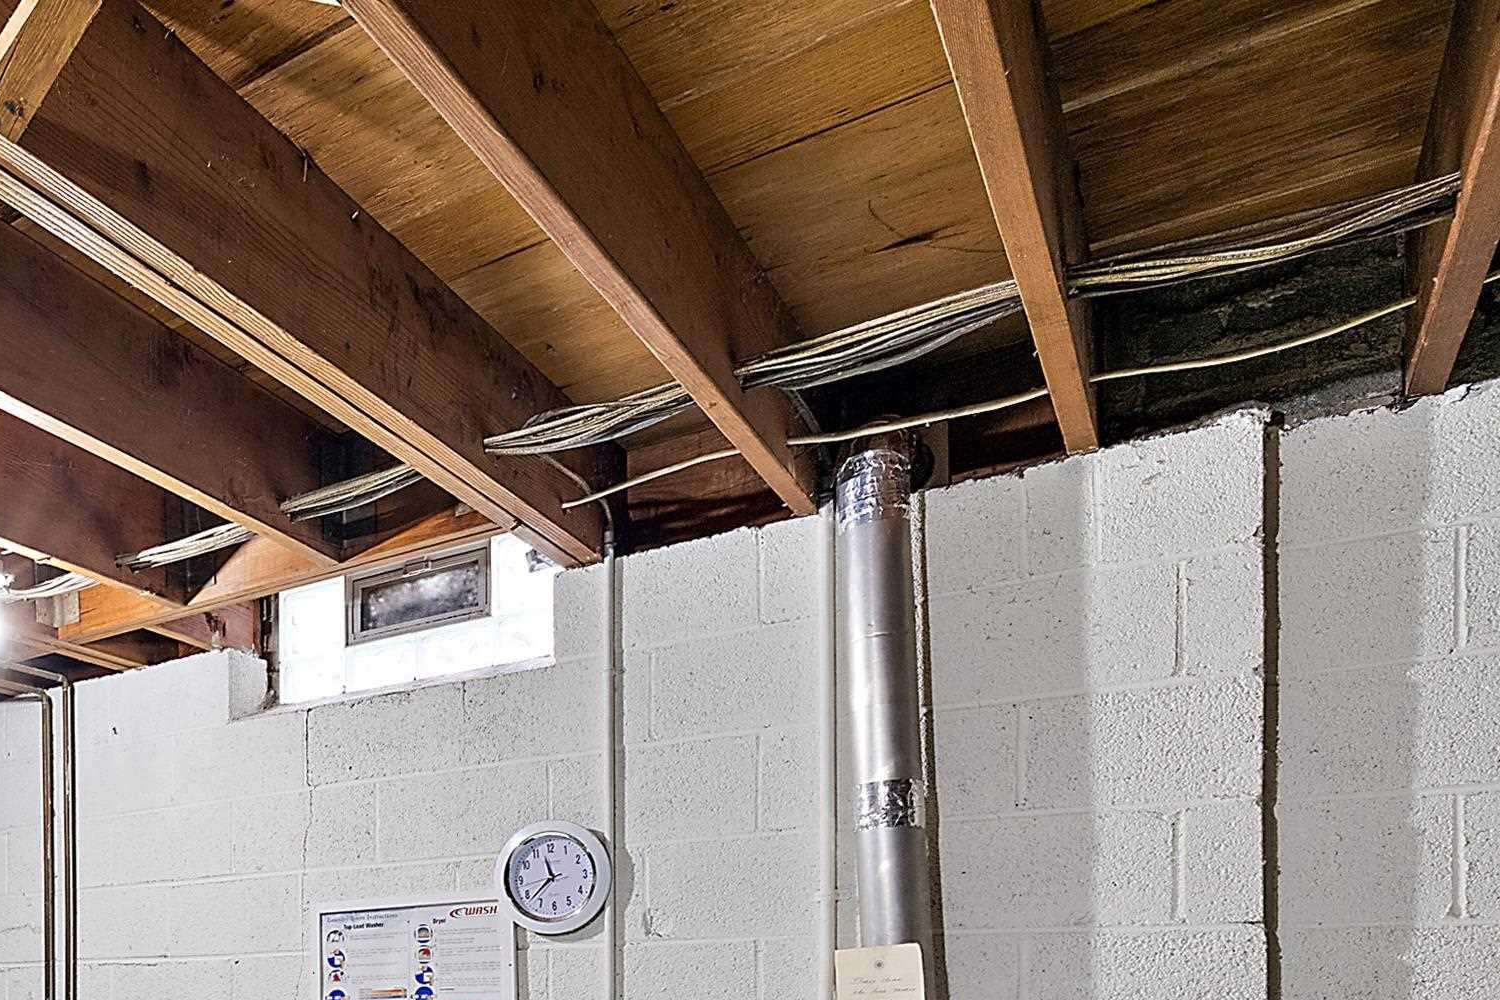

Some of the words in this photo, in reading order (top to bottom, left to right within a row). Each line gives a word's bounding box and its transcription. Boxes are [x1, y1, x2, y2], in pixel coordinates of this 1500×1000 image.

[546, 843, 555, 853] 12
[564, 845, 568, 855] 1
[532, 848, 540, 859] 11
[575, 854, 581, 864] 2
[522, 860, 531, 870] 10
[582, 869, 588, 879] 3
[518, 875, 524, 885] 9
[524, 889, 531, 900] 8
[577, 885, 583, 895] 4
[538, 898, 543, 908] 7
[552, 900, 558, 911] 6
[566, 896, 572, 906] 5
[465, 905, 498, 916] WASH
